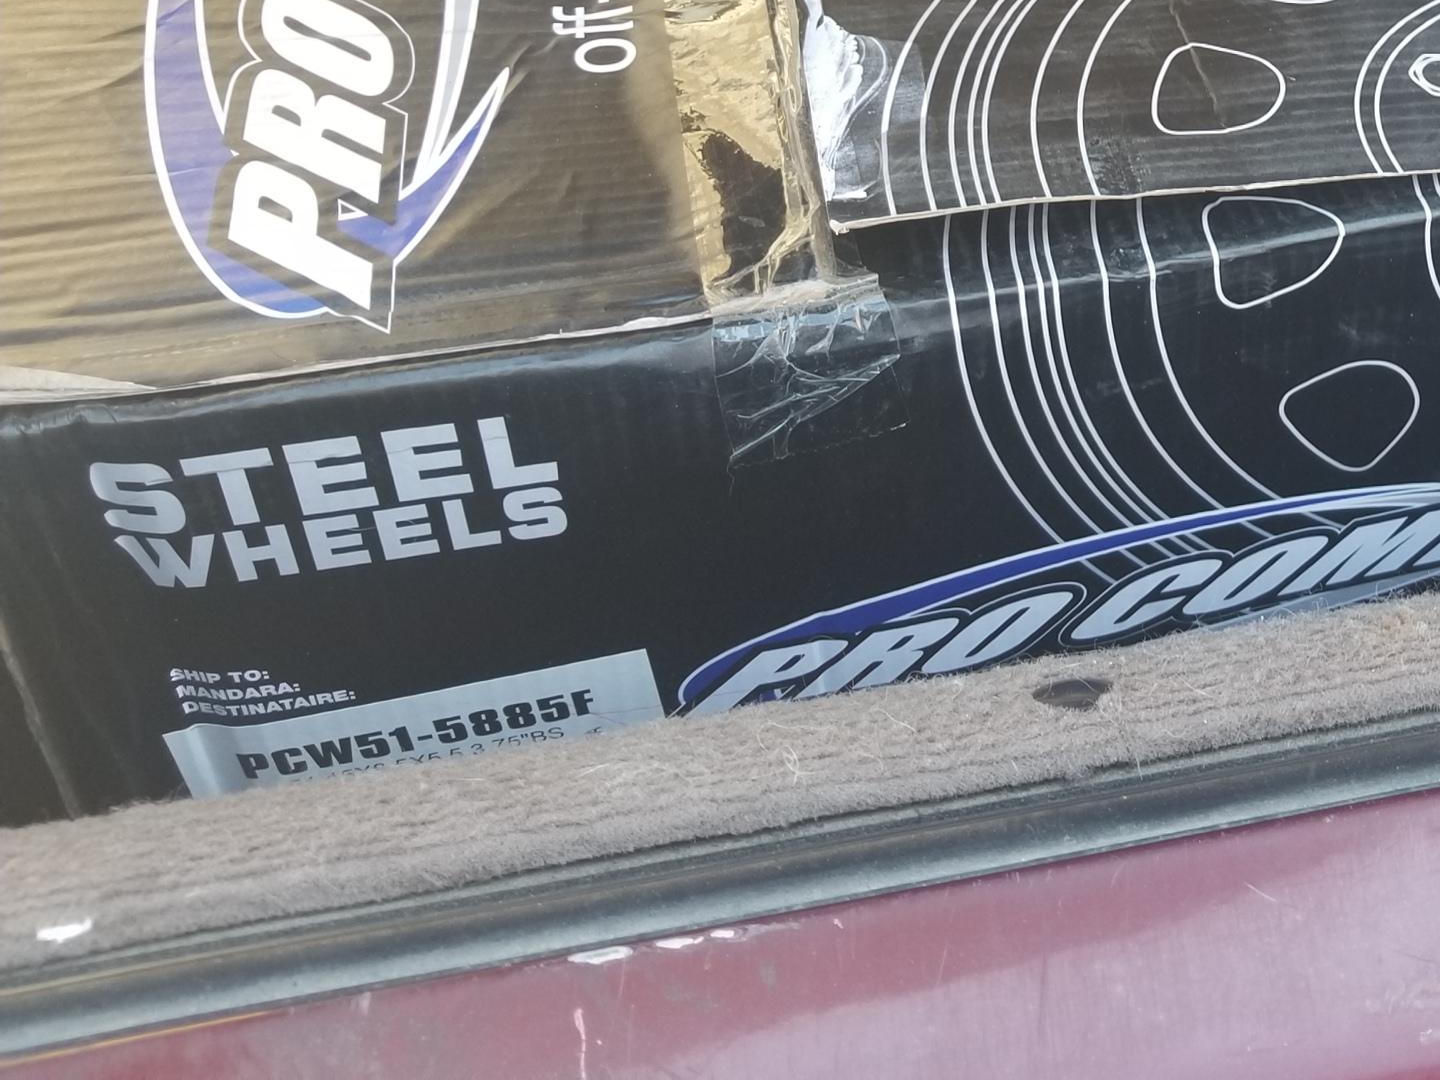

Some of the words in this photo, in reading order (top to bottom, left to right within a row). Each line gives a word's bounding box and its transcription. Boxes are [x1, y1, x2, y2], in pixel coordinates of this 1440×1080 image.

[89, 416, 559, 535] STEEL
[114, 486, 568, 589] WHEELS
[170, 667, 221, 684] SHIP
[228, 669, 270, 683] TO:
[175, 681, 301, 701] MANDARA:
[688, 591, 1074, 719] PRO
[181, 688, 357, 718] DESTINATAIRE:
[236, 688, 594, 780] PCW51-5885F
